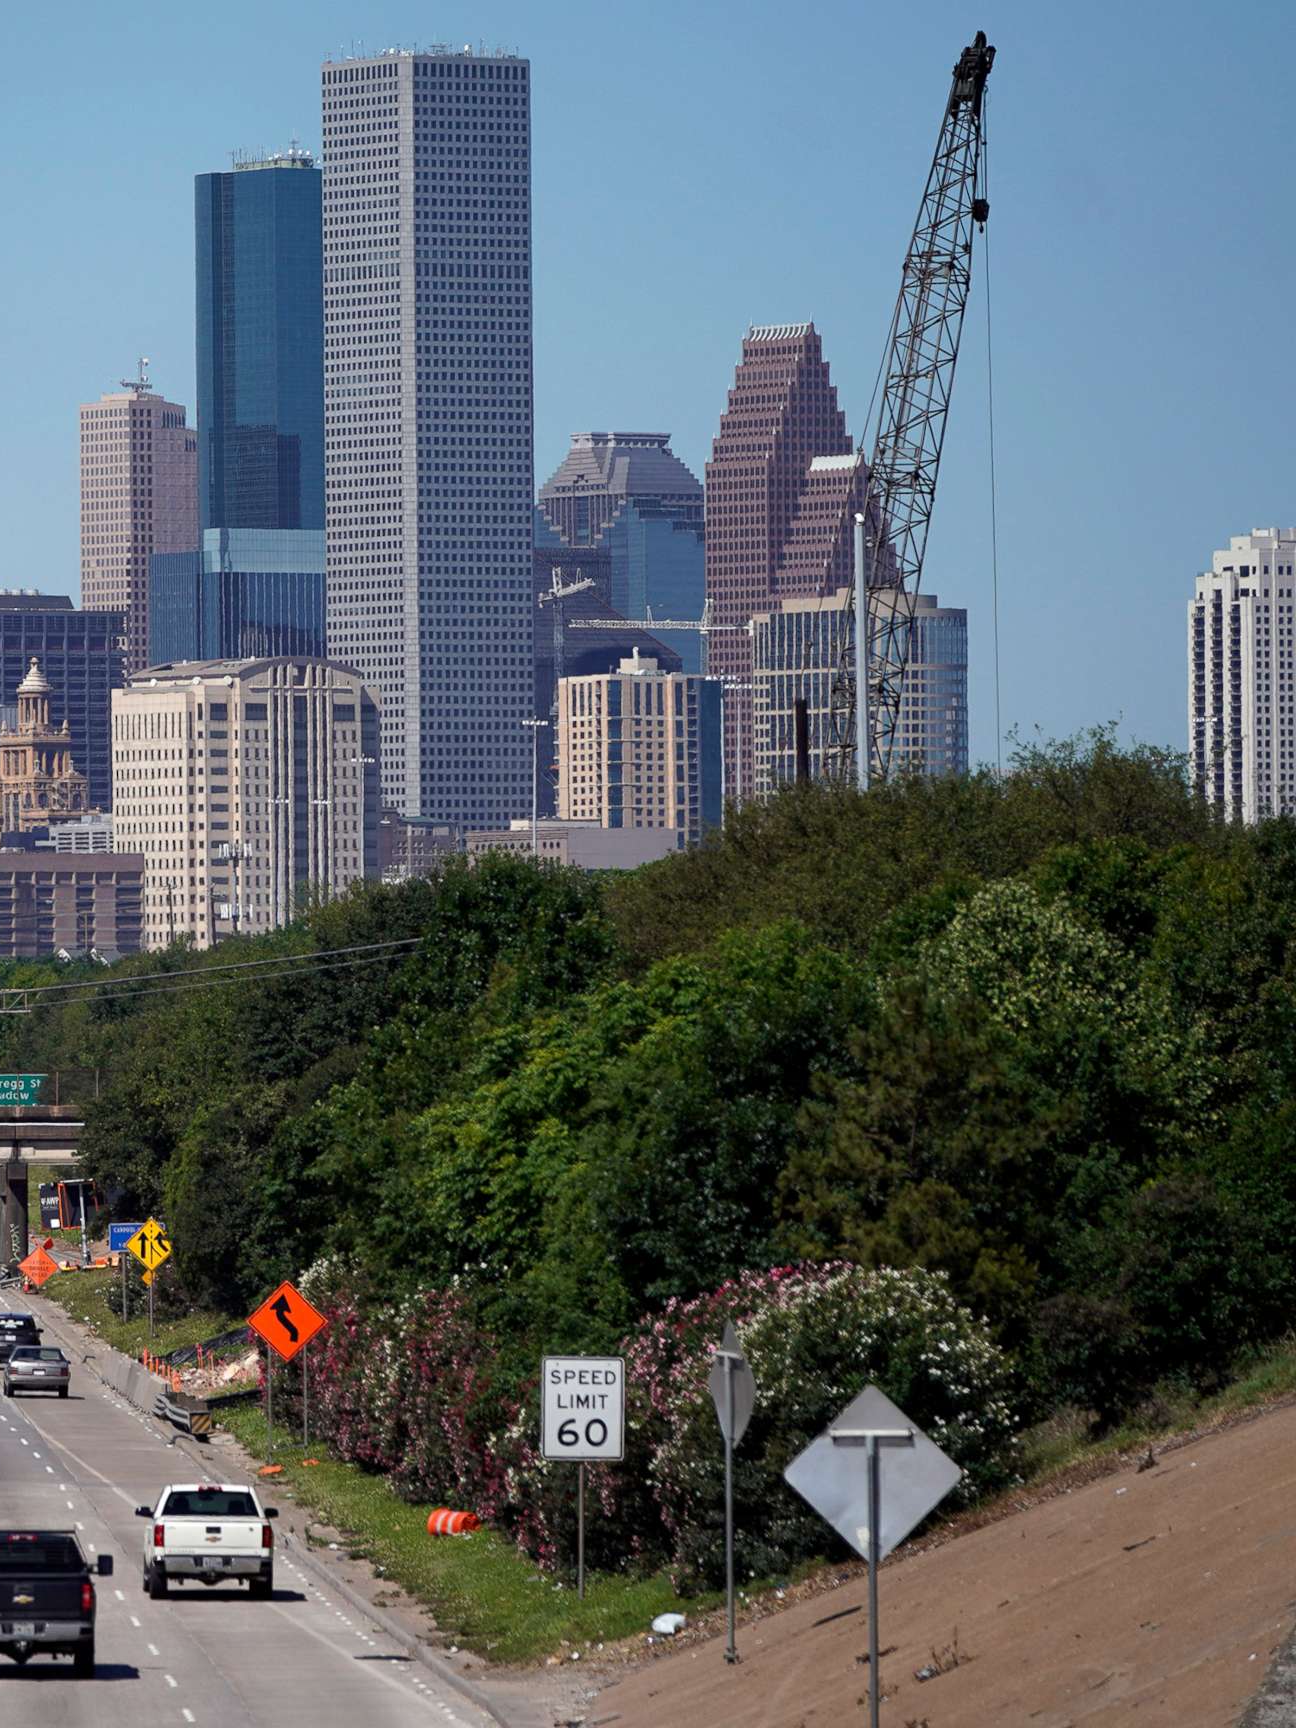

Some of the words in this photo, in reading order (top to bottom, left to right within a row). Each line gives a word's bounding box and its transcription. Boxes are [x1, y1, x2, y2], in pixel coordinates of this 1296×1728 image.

[30, 1079, 41, 1088] St
[550, 1370, 617, 1385] SPEED
[557, 1394, 609, 1410] LIMIT
[557, 1418, 609, 1447] 60
